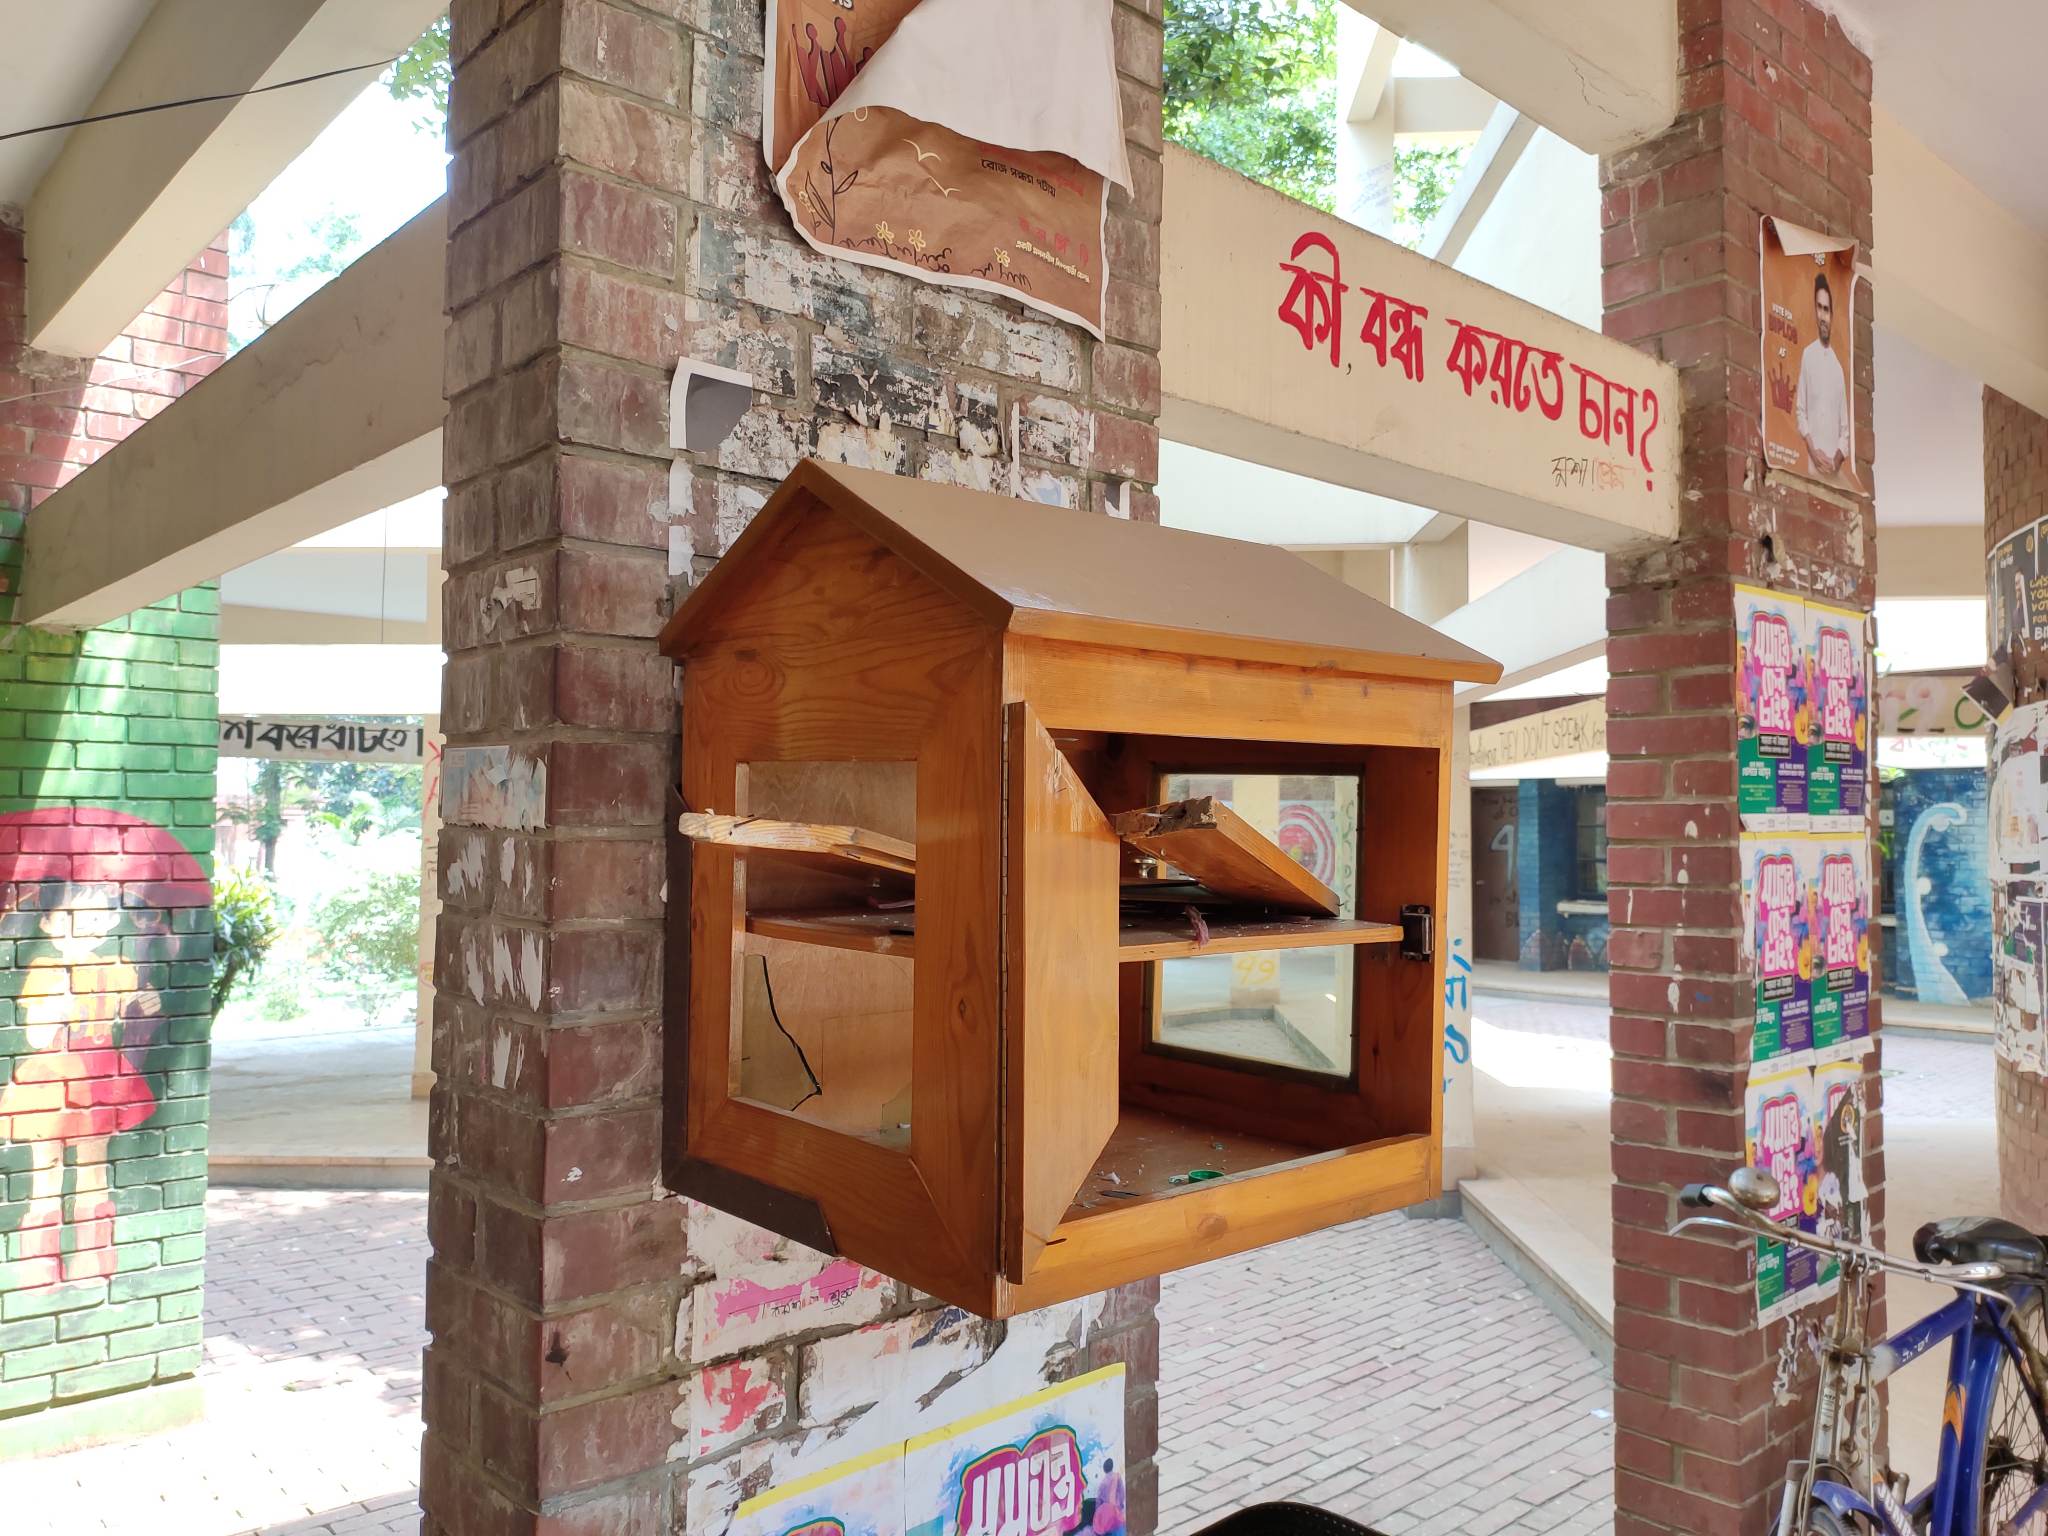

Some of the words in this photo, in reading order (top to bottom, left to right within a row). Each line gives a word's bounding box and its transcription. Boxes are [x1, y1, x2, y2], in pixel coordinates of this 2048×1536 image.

[1772, 303, 1785, 317] VOTE
[1361, 288, 1427, 381] বন্ধ
[1447, 320, 1563, 420] করতে
[1571, 365, 1658, 490] চান?
[2029, 575, 2048, 588] CAS
[2031, 589, 2048, 600] YOU
[2032, 601, 2048, 612] VOT
[256, 724, 322, 752] করে
